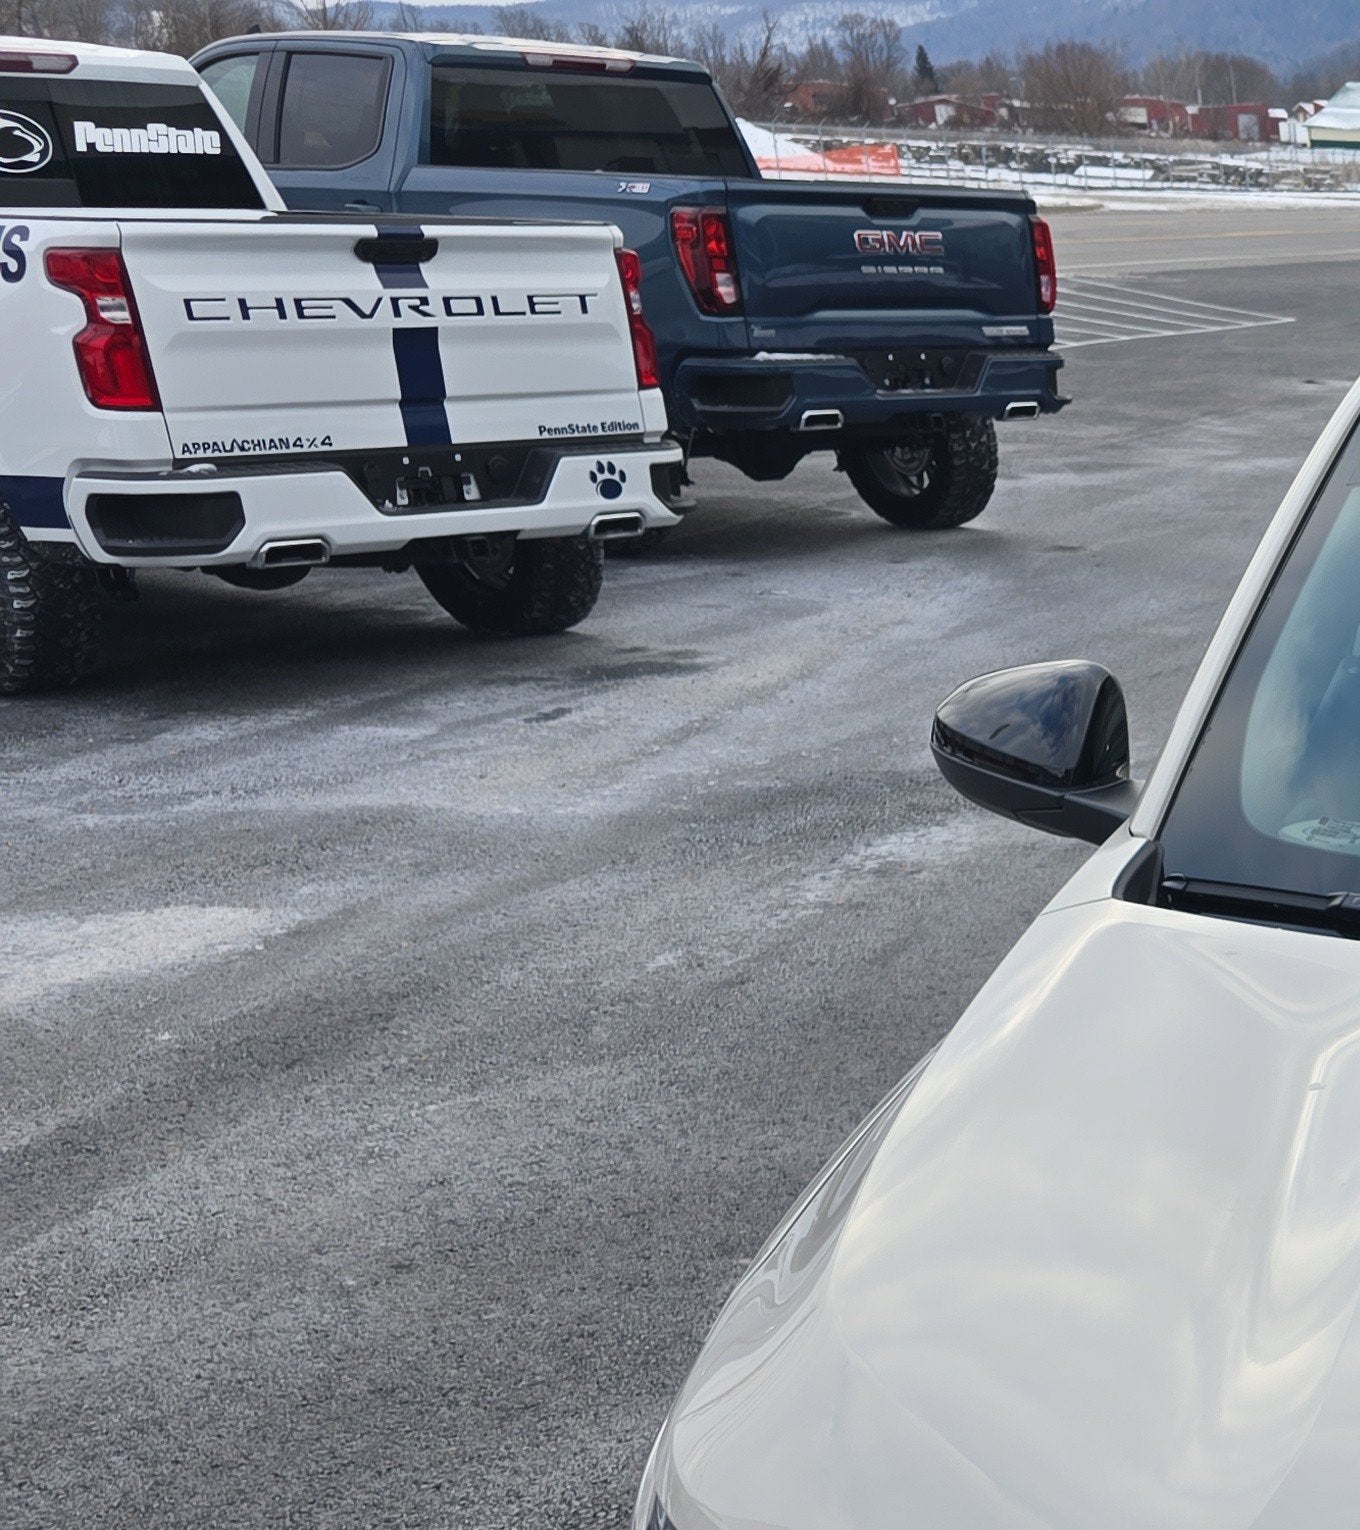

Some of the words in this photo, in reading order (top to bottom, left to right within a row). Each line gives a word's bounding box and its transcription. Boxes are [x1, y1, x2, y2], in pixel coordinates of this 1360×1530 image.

[853, 229, 945, 255] GMC
[183, 293, 599, 321] CHEVROLET
[538, 422, 599, 437] PennState
[600, 420, 640, 433] Edition
